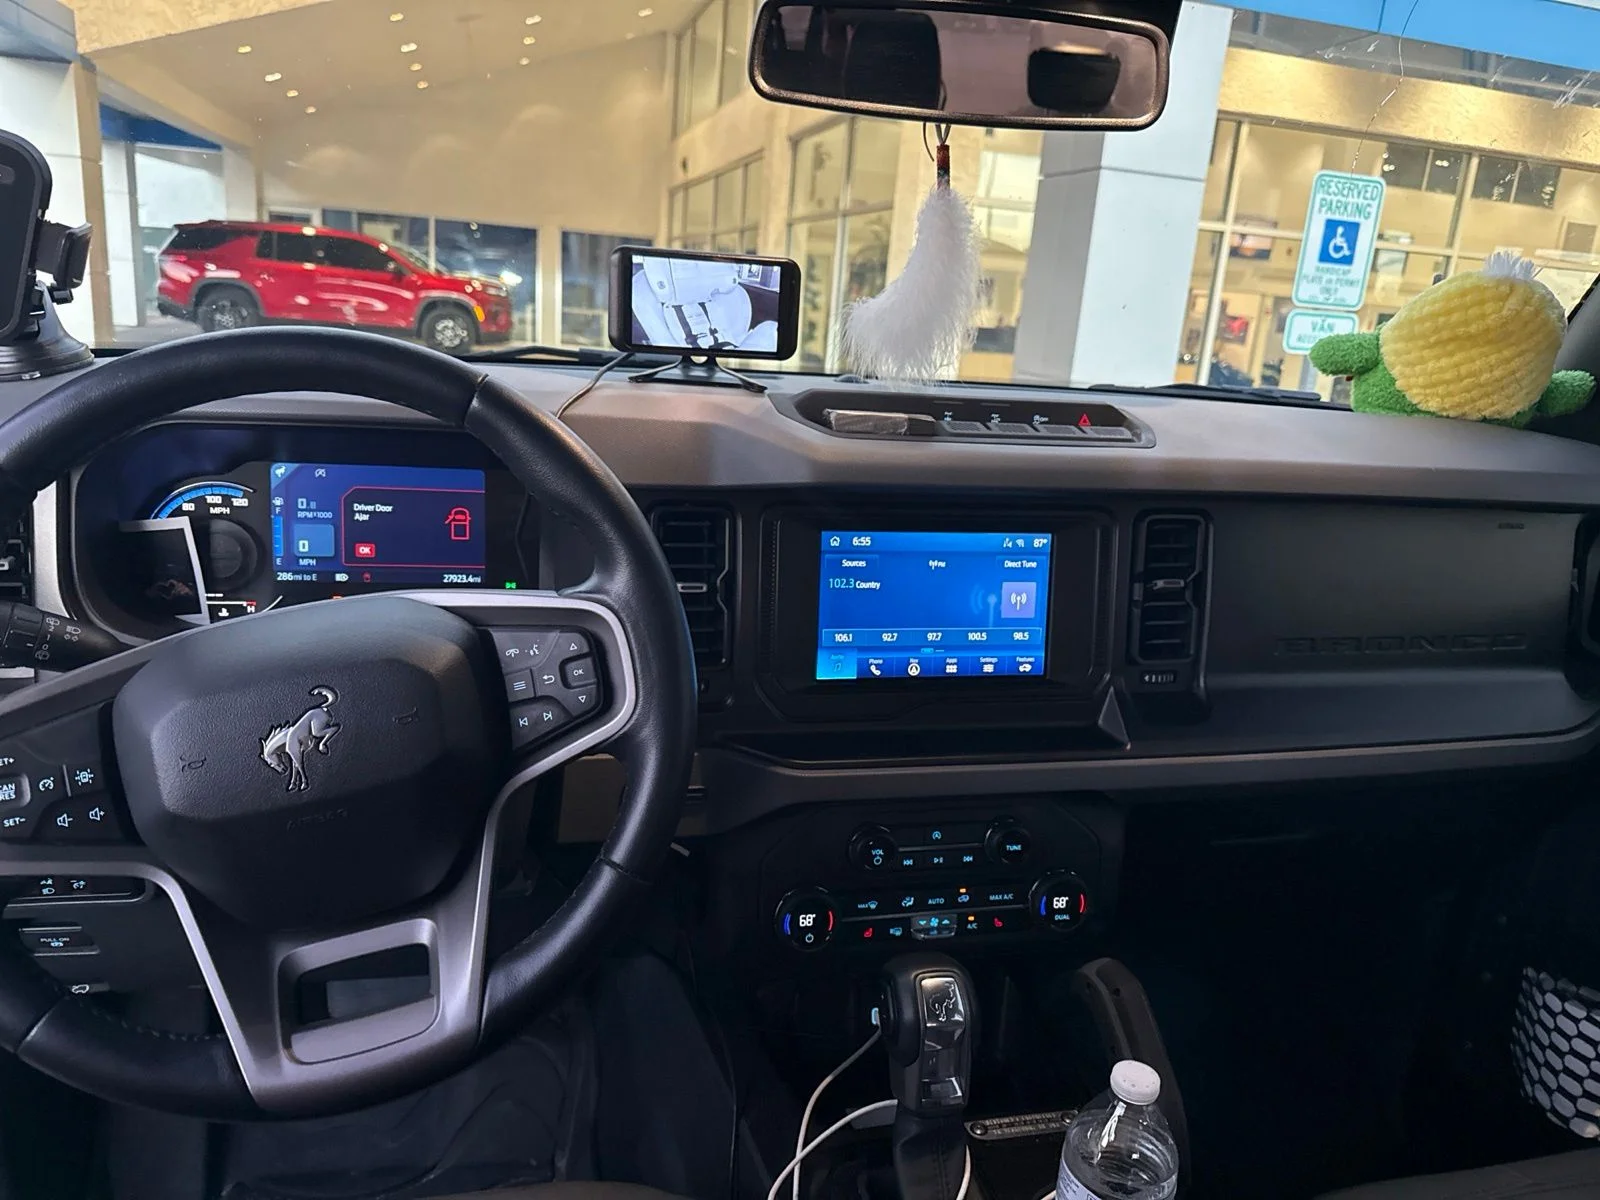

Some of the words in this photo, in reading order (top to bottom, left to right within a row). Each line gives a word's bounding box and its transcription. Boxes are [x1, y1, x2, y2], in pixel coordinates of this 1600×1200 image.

[1317, 179, 1379, 201] RESERVED
[1318, 200, 1373, 219] PARKING
[1311, 320, 1335, 333] VAN
[205, 495, 222, 504] 100
[231, 498, 248, 507] 120
[209, 507, 230, 515] MPH
[353, 503, 375, 512] Driver
[375, 504, 393, 512] Door
[354, 513, 370, 521] Ajar
[852, 536, 871, 546] 6:55
[299, 540, 309, 552] 0
[359, 546, 371, 554] OK
[299, 558, 317, 566] MPH
[842, 559, 867, 568] Sources
[1004, 560, 1021, 568] Direct
[1022, 560, 1038, 568] Tune
[303, 573, 311, 581] to
[828, 578, 855, 589] 102.3
[855, 581, 881, 590] Country
[882, 633, 898, 641] 92.7
[927, 632, 942, 641] 97.7
[967, 632, 987, 641] 100.5
[1013, 632, 1029, 640] 98.5
[573, 668, 584, 676] OK
